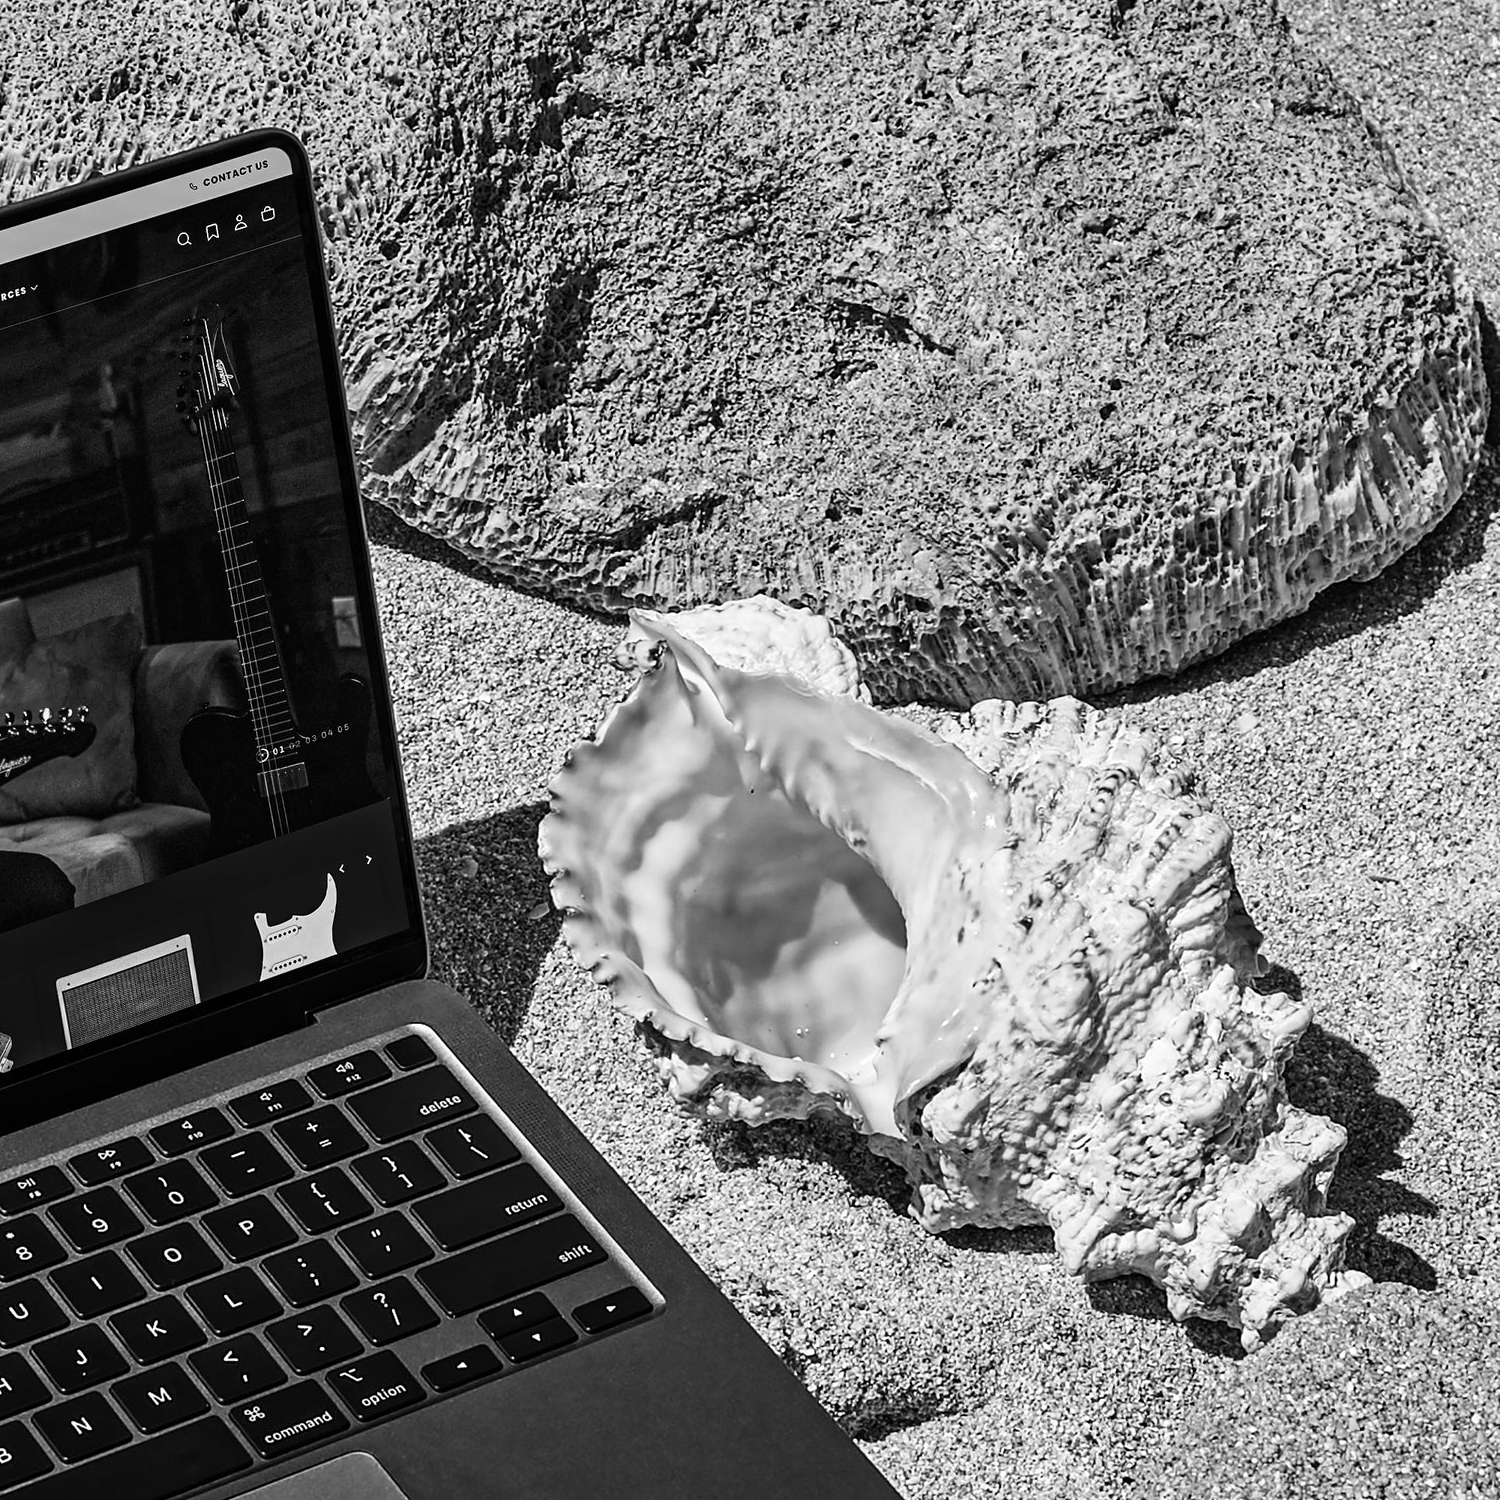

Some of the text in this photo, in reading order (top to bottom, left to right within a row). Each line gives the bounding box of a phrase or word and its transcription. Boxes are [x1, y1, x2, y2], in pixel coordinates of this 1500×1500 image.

[203, 160, 269, 186] CONTACT US
[273, 746, 285, 756] 01
[305, 735, 317, 744] 03
[321, 729, 333, 739] 04
[337, 723, 349, 733] 05
[419, 1095, 462, 1116] delete
[167, 1191, 185, 1205] 0
[504, 1194, 548, 1216] return
[91, 1218, 109, 1233] 9
[238, 1220, 254, 1236] P
[15, 1246, 33, 1261] 8
[163, 1247, 182, 1263] O
[558, 1244, 593, 1263] shift
[90, 1276, 103, 1291] I
[223, 1294, 244, 1308] L
[8, 1302, 29, 1320] U
[145, 1319, 168, 1338] K
[76, 1349, 88, 1365] J
[147, 1386, 172, 1406] M
[361, 1384, 407, 1407] option
[70, 1416, 93, 1435] N
[264, 1410, 333, 1444] command
